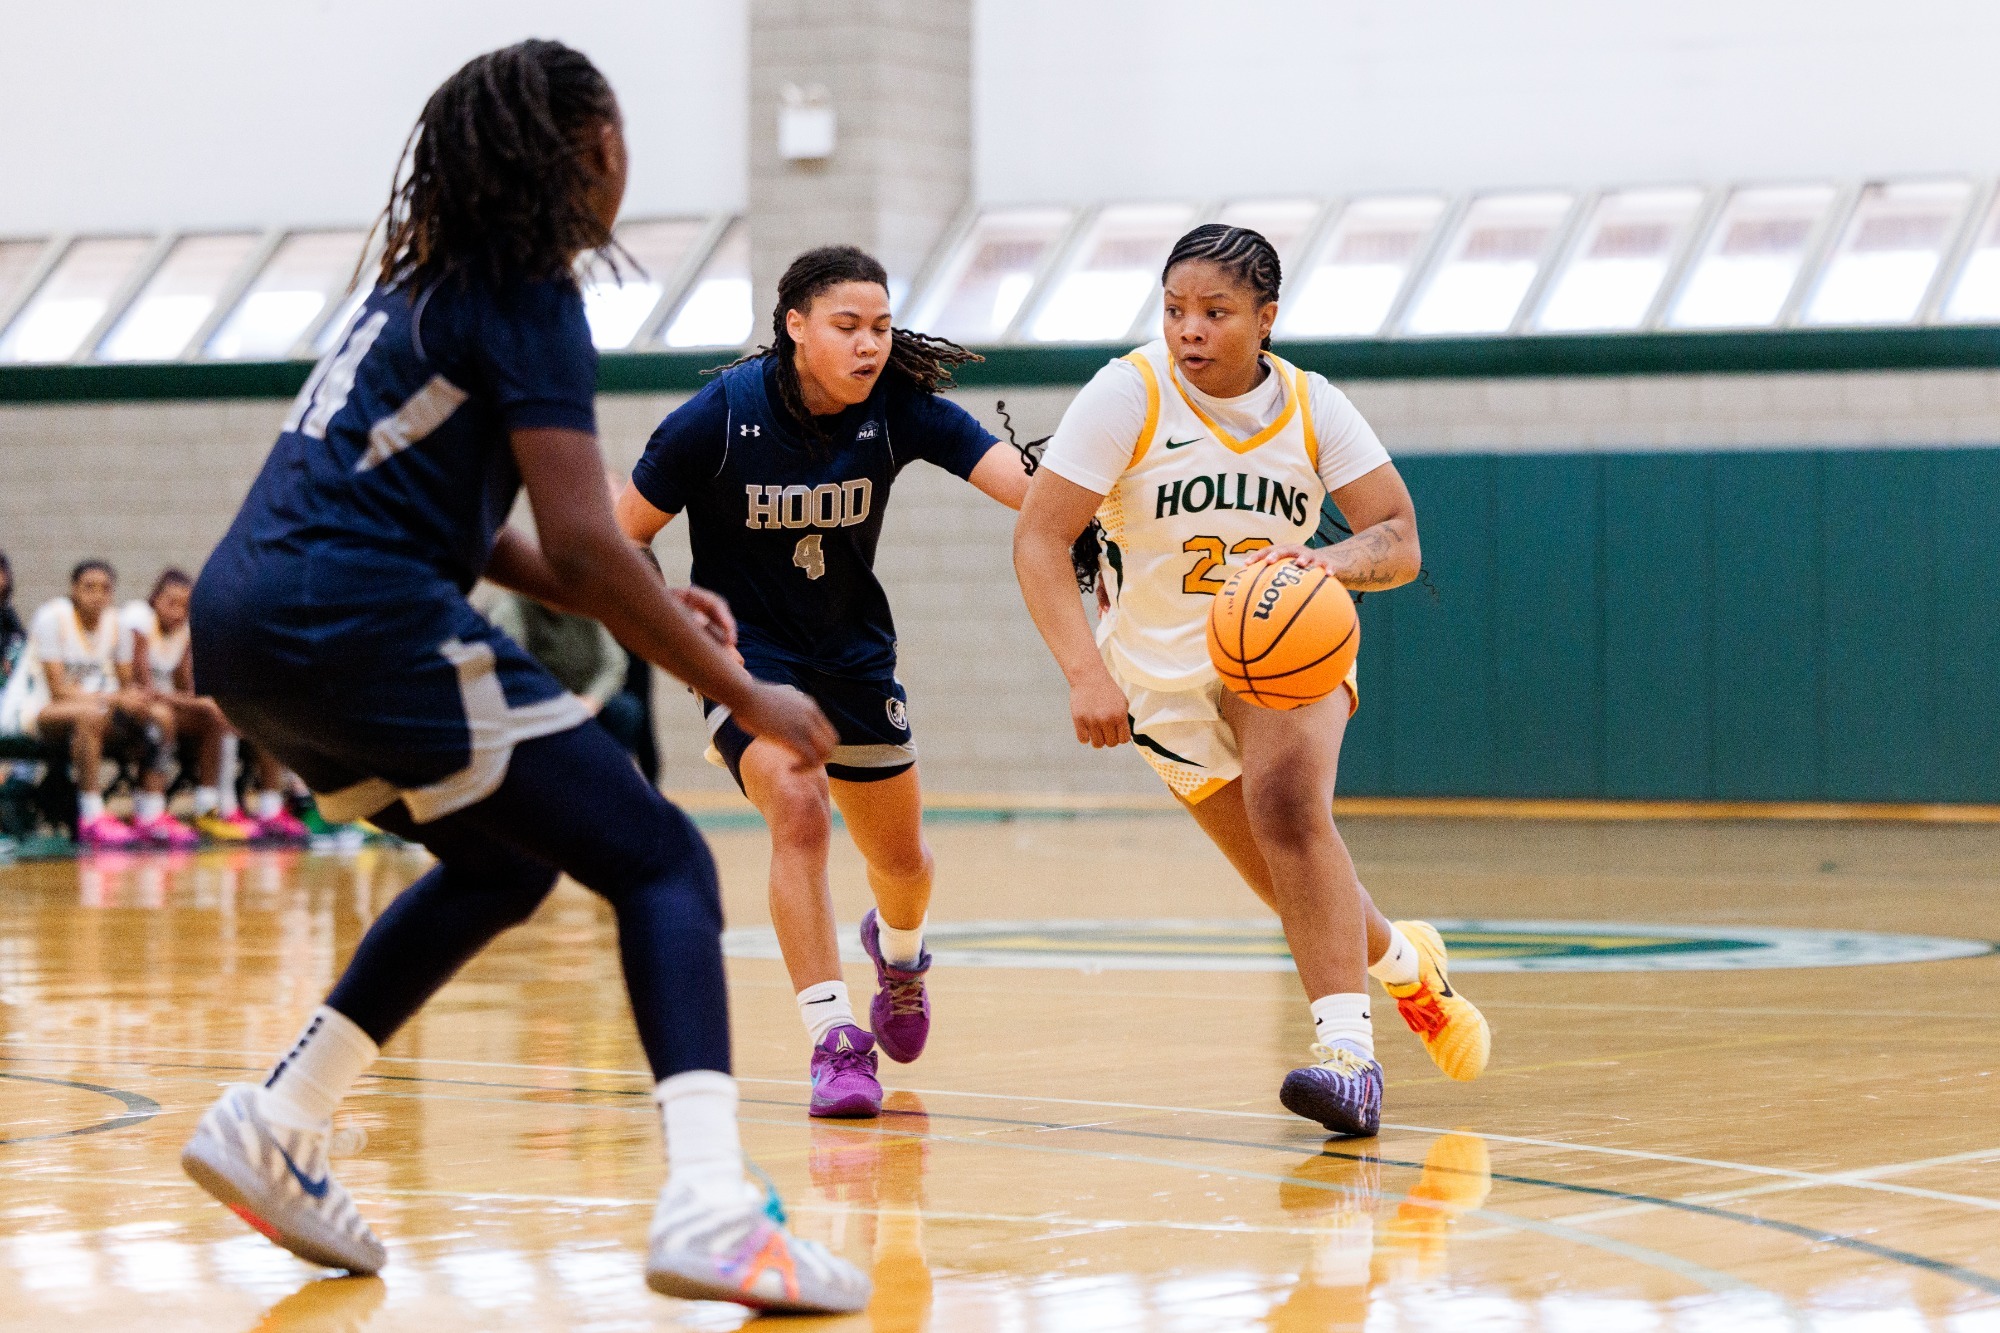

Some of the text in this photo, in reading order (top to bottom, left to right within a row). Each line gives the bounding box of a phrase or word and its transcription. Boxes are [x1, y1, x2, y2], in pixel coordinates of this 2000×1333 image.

[746, 478, 872, 529] HOOD
[1155, 473, 1309, 527] HOLLINS
[792, 534, 825, 580] 4
[1182, 535, 1275, 595] 2
